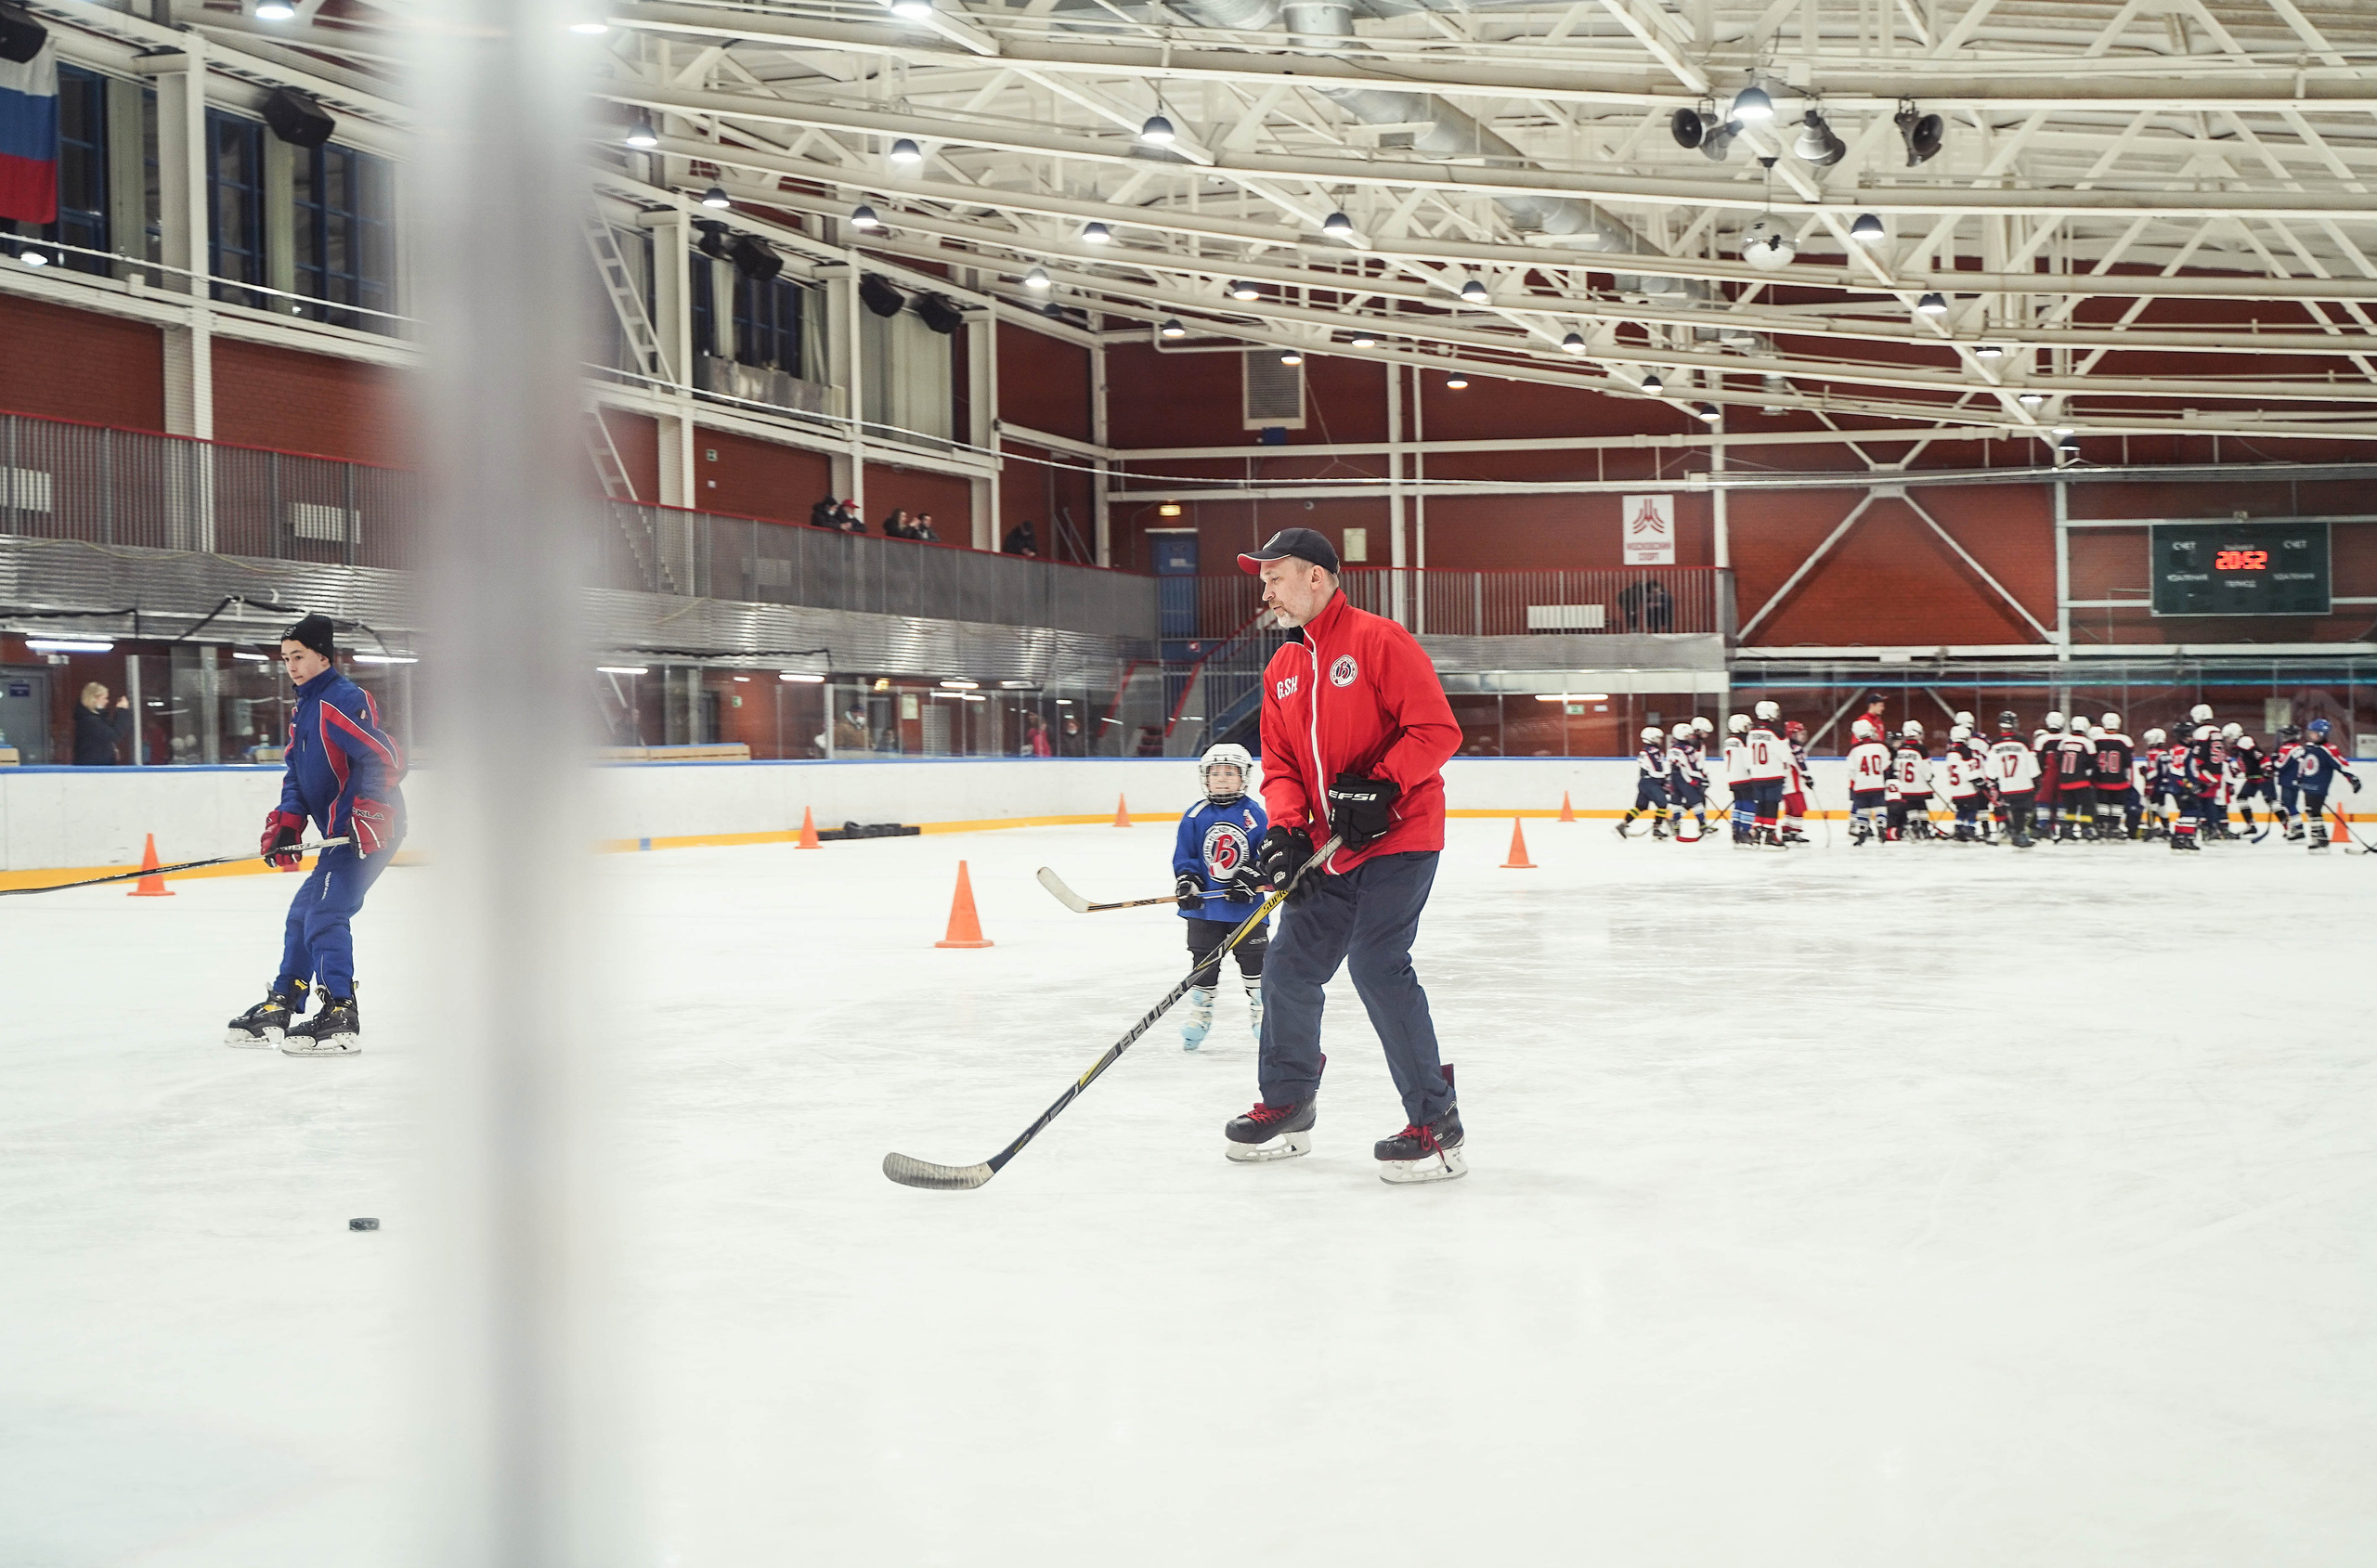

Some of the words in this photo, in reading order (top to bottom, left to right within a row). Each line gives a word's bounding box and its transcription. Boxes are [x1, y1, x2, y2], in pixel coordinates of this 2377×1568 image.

[1751, 743, 1769, 765] 10
[1860, 754, 1882, 776] 40
[2098, 750, 2121, 773] 40
[2002, 755, 2018, 778] 17
[1328, 789, 1377, 801] EFSI
